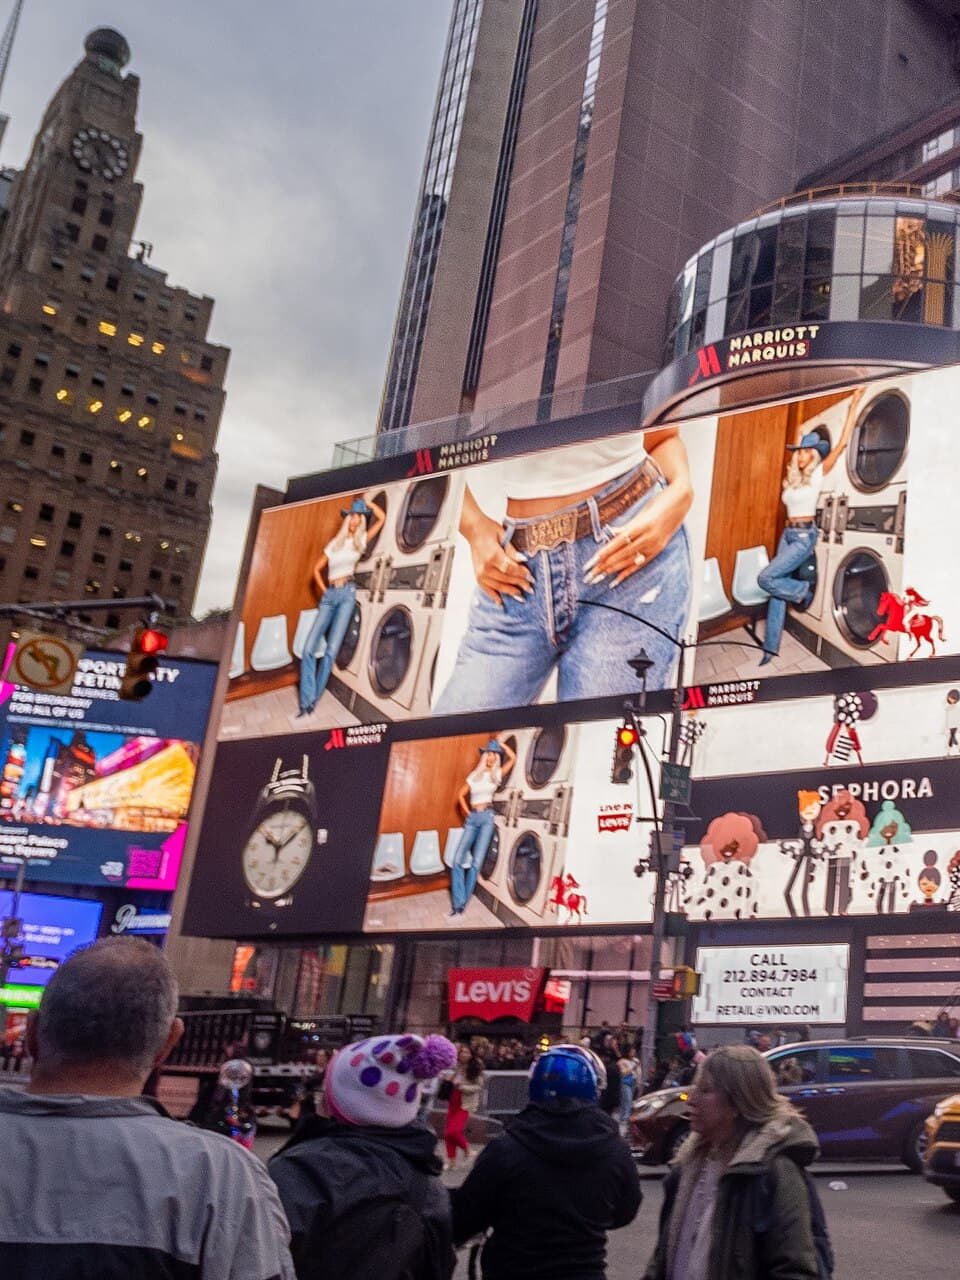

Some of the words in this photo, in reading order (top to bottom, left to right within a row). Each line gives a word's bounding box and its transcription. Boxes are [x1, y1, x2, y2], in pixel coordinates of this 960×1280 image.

[730, 325, 819, 351] MARRIOTT
[728, 343, 806, 368] MARQUIS
[440, 435, 498, 457] MARRIOTT
[438, 449, 489, 469] MARQUIS
[709, 680, 760, 695] MARRIOTT
[708, 692, 754, 705] MARQUIS
[347, 723, 387, 736] MARRIOTT
[818, 777, 934, 806] SEPHORA
[750, 953, 788, 966] CALL
[723, 969, 818, 983] 212.894.7984
[740, 987, 795, 998] CONTACT
[716, 1004, 820, 1016] RETAIL@VNO.COM
